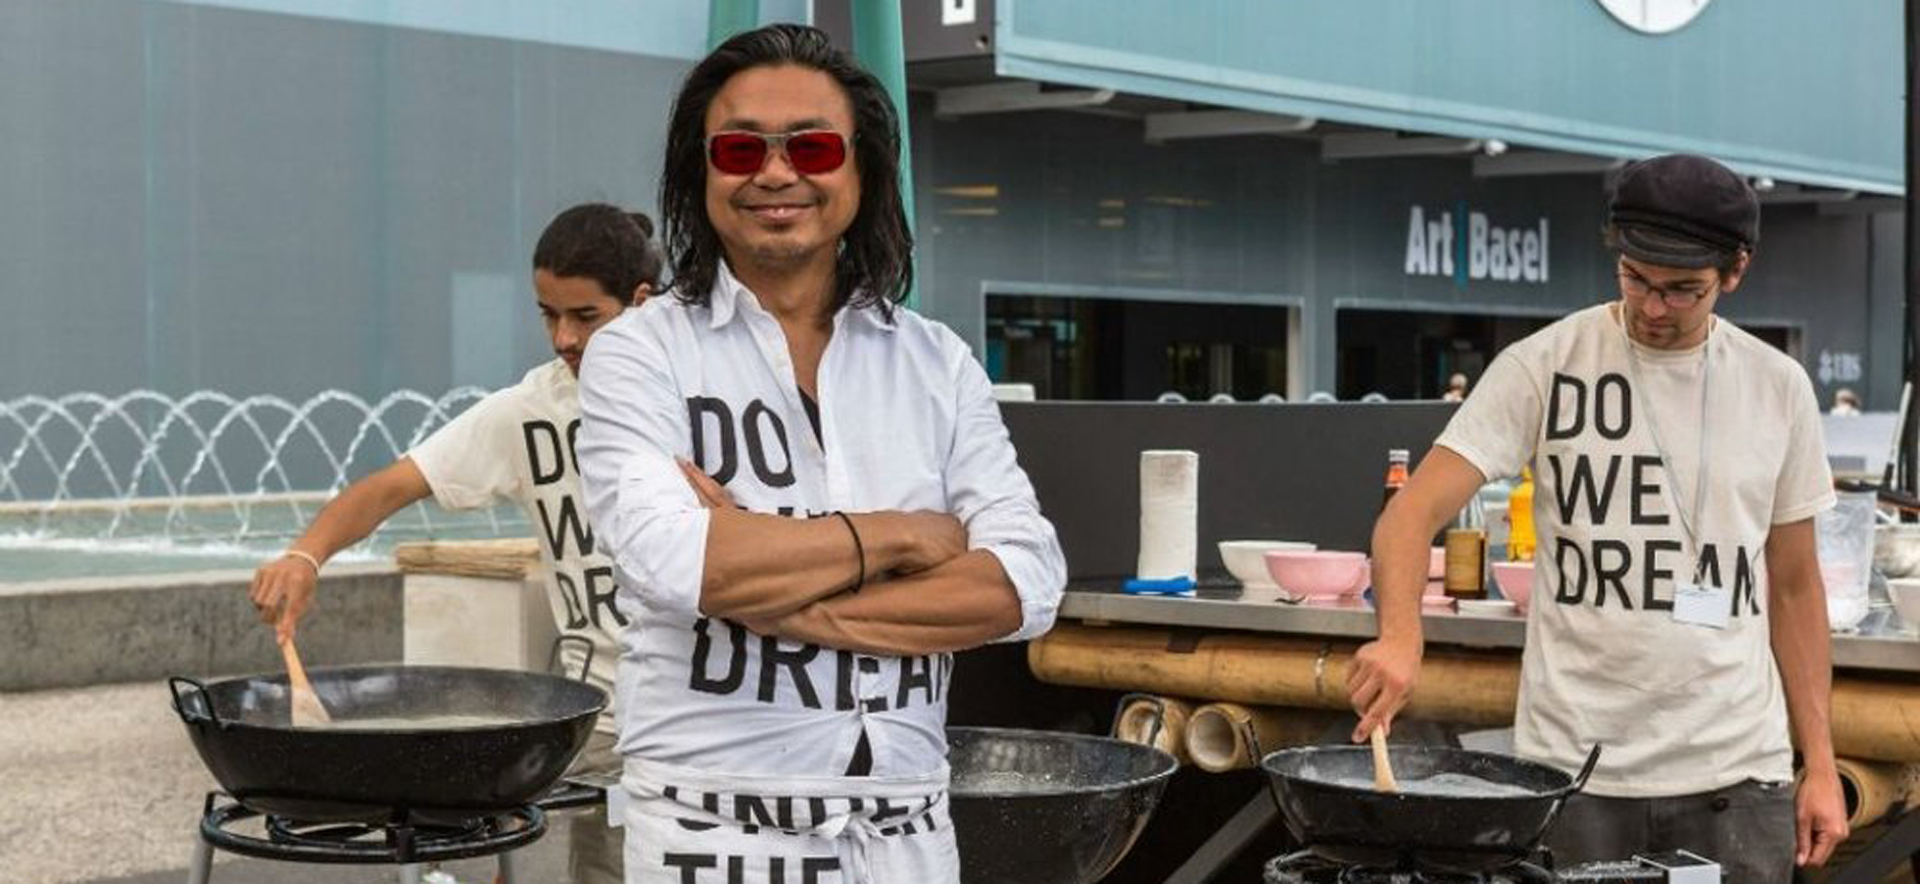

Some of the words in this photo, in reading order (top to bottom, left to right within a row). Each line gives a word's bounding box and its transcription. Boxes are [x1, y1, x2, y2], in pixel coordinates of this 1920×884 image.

[1405, 205, 1454, 275] Art
[1469, 212, 1548, 282] Basel
[686, 395, 797, 488] DO
[1545, 372, 1632, 440] DO
[1547, 454, 1670, 526] WE
[689, 617, 947, 713] DREA
